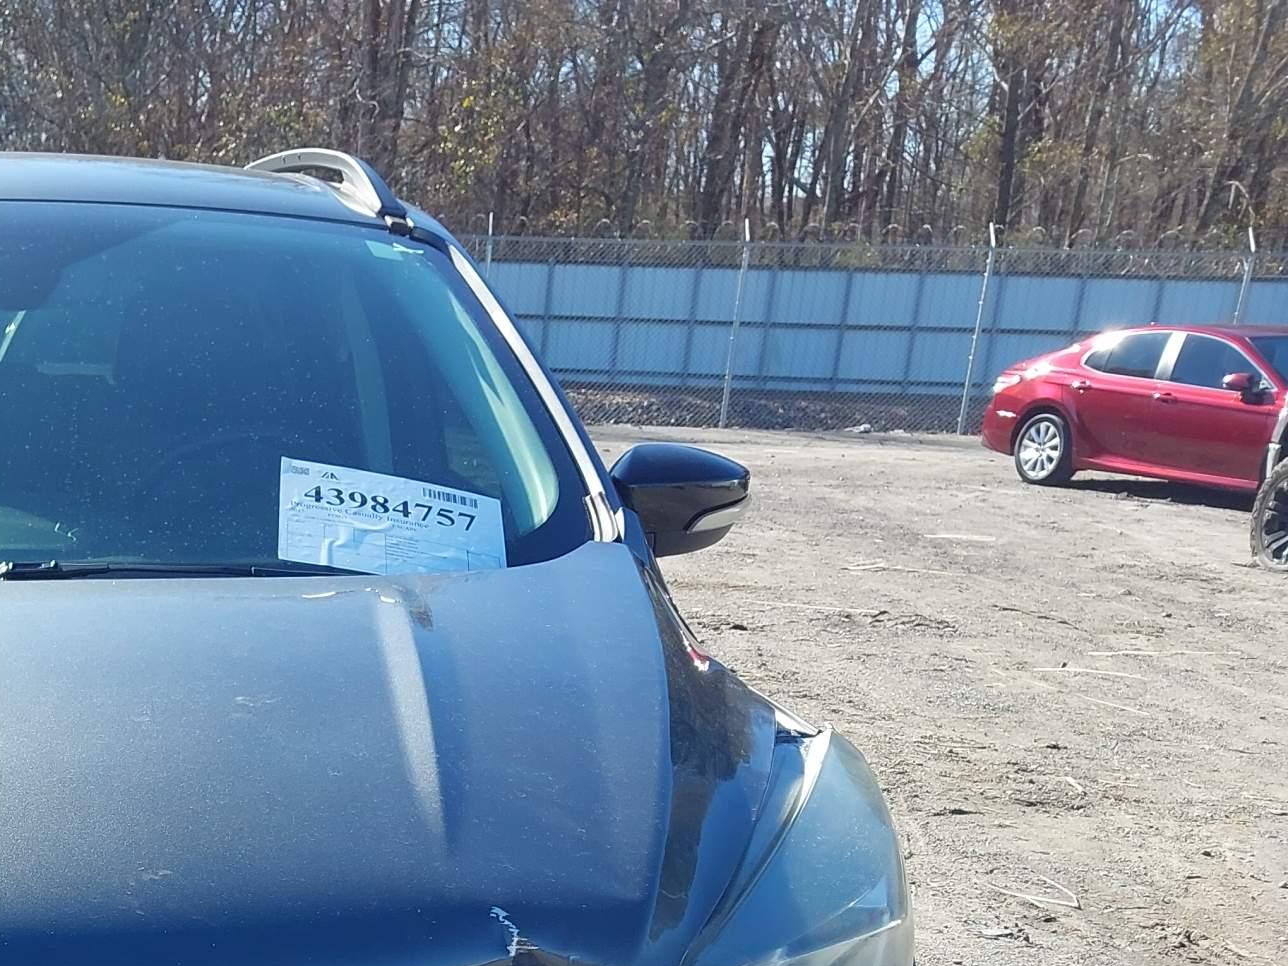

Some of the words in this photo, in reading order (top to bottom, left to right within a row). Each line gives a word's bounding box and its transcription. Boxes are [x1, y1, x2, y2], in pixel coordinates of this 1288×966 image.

[290, 500, 343, 514] Progressive
[344, 509, 383, 521] Casualty
[387, 516, 430, 529] Insurance
[303, 485, 477, 532] 43984757
